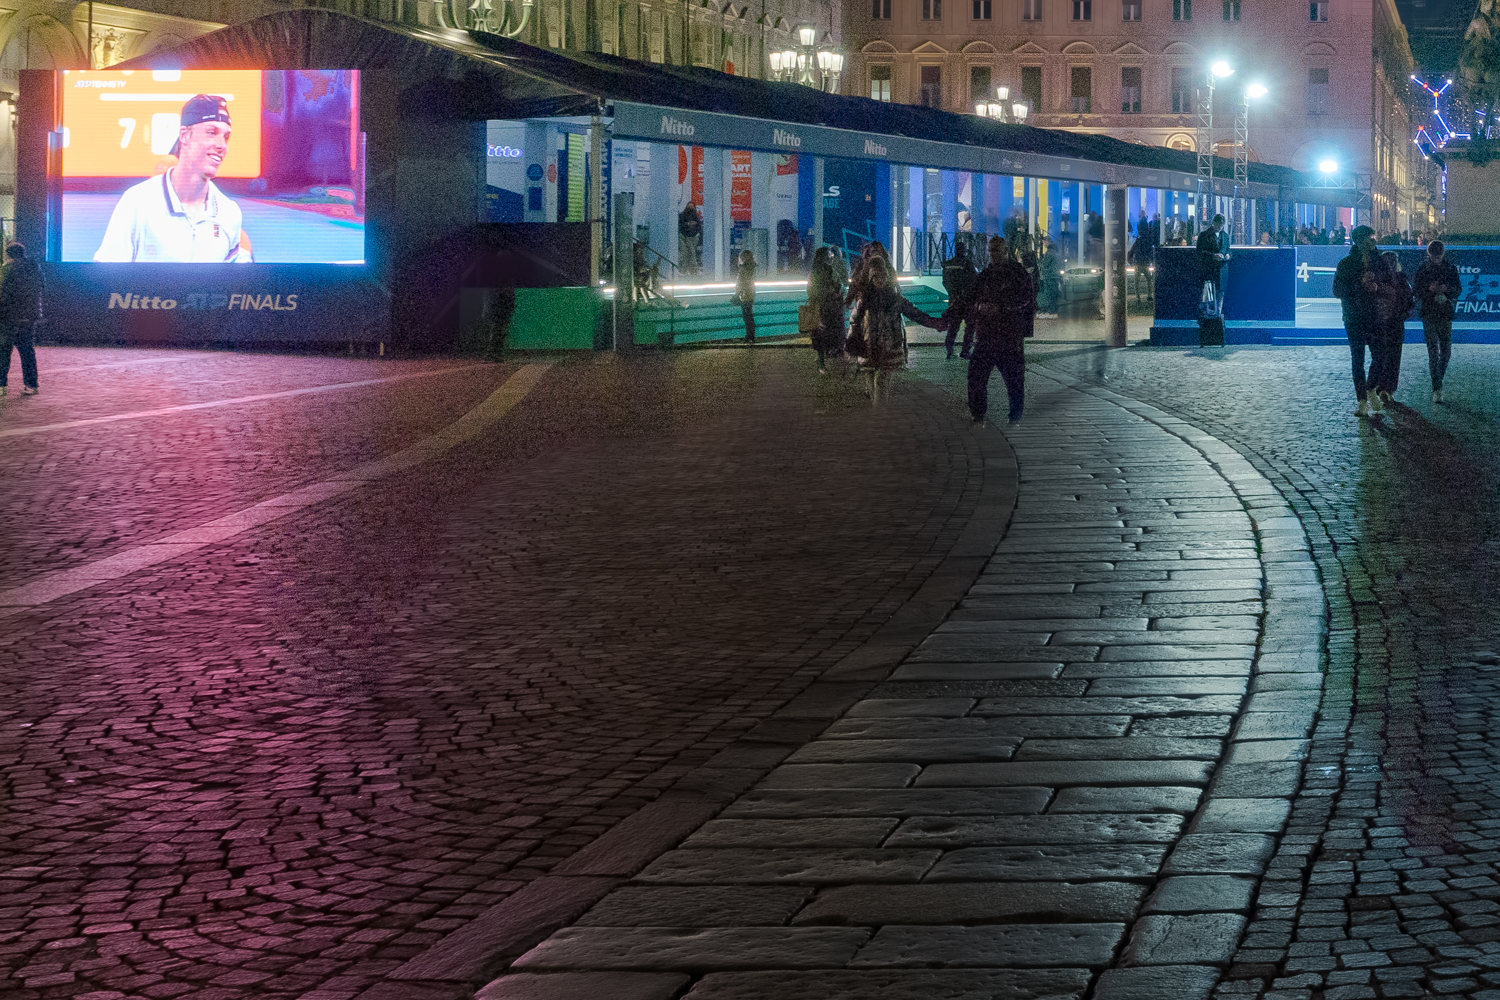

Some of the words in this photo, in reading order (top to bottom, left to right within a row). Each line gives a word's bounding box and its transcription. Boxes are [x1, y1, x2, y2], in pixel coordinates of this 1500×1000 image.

[118, 118, 136, 149] 7
[661, 115, 695, 136] Nitto
[773, 128, 801, 147] Nitto
[487, 143, 523, 158] itto
[864, 139, 887, 156] Nitto
[1297, 262, 1309, 282] 4
[1456, 265, 1481, 274] itto
[108, 292, 177, 310] Nitto
[228, 294, 298, 311] FINALS
